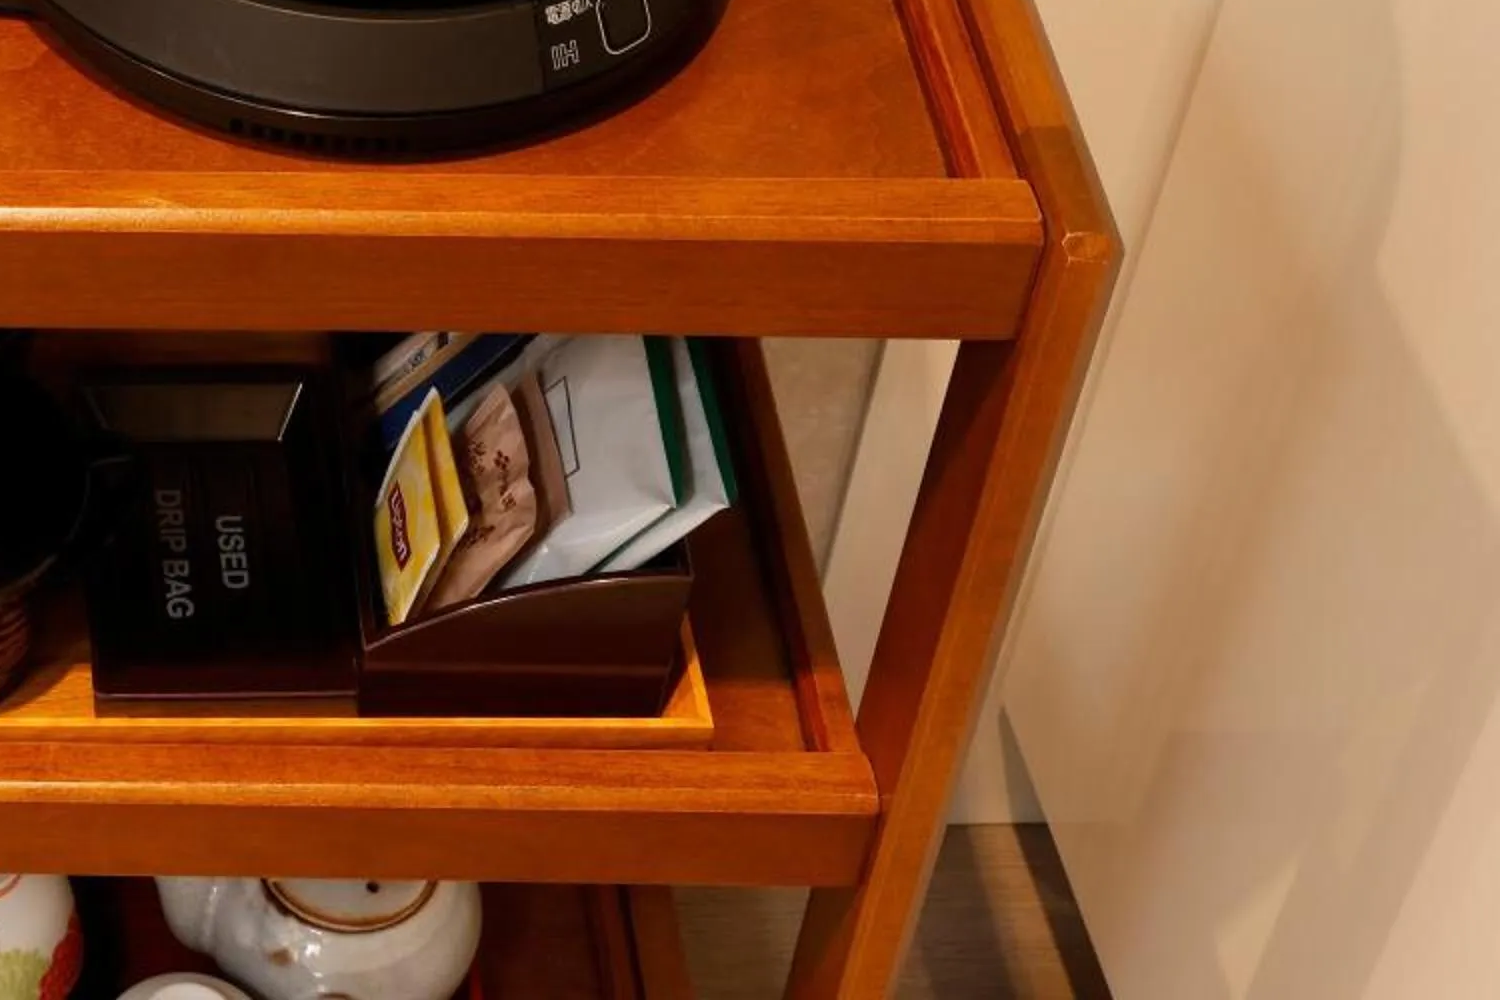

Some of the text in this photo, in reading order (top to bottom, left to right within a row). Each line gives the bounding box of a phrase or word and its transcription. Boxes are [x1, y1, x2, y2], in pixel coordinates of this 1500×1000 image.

[551, 39, 580, 71] IH
[156, 489, 196, 619] DRIP BAG
[215, 515, 249, 589] USED
